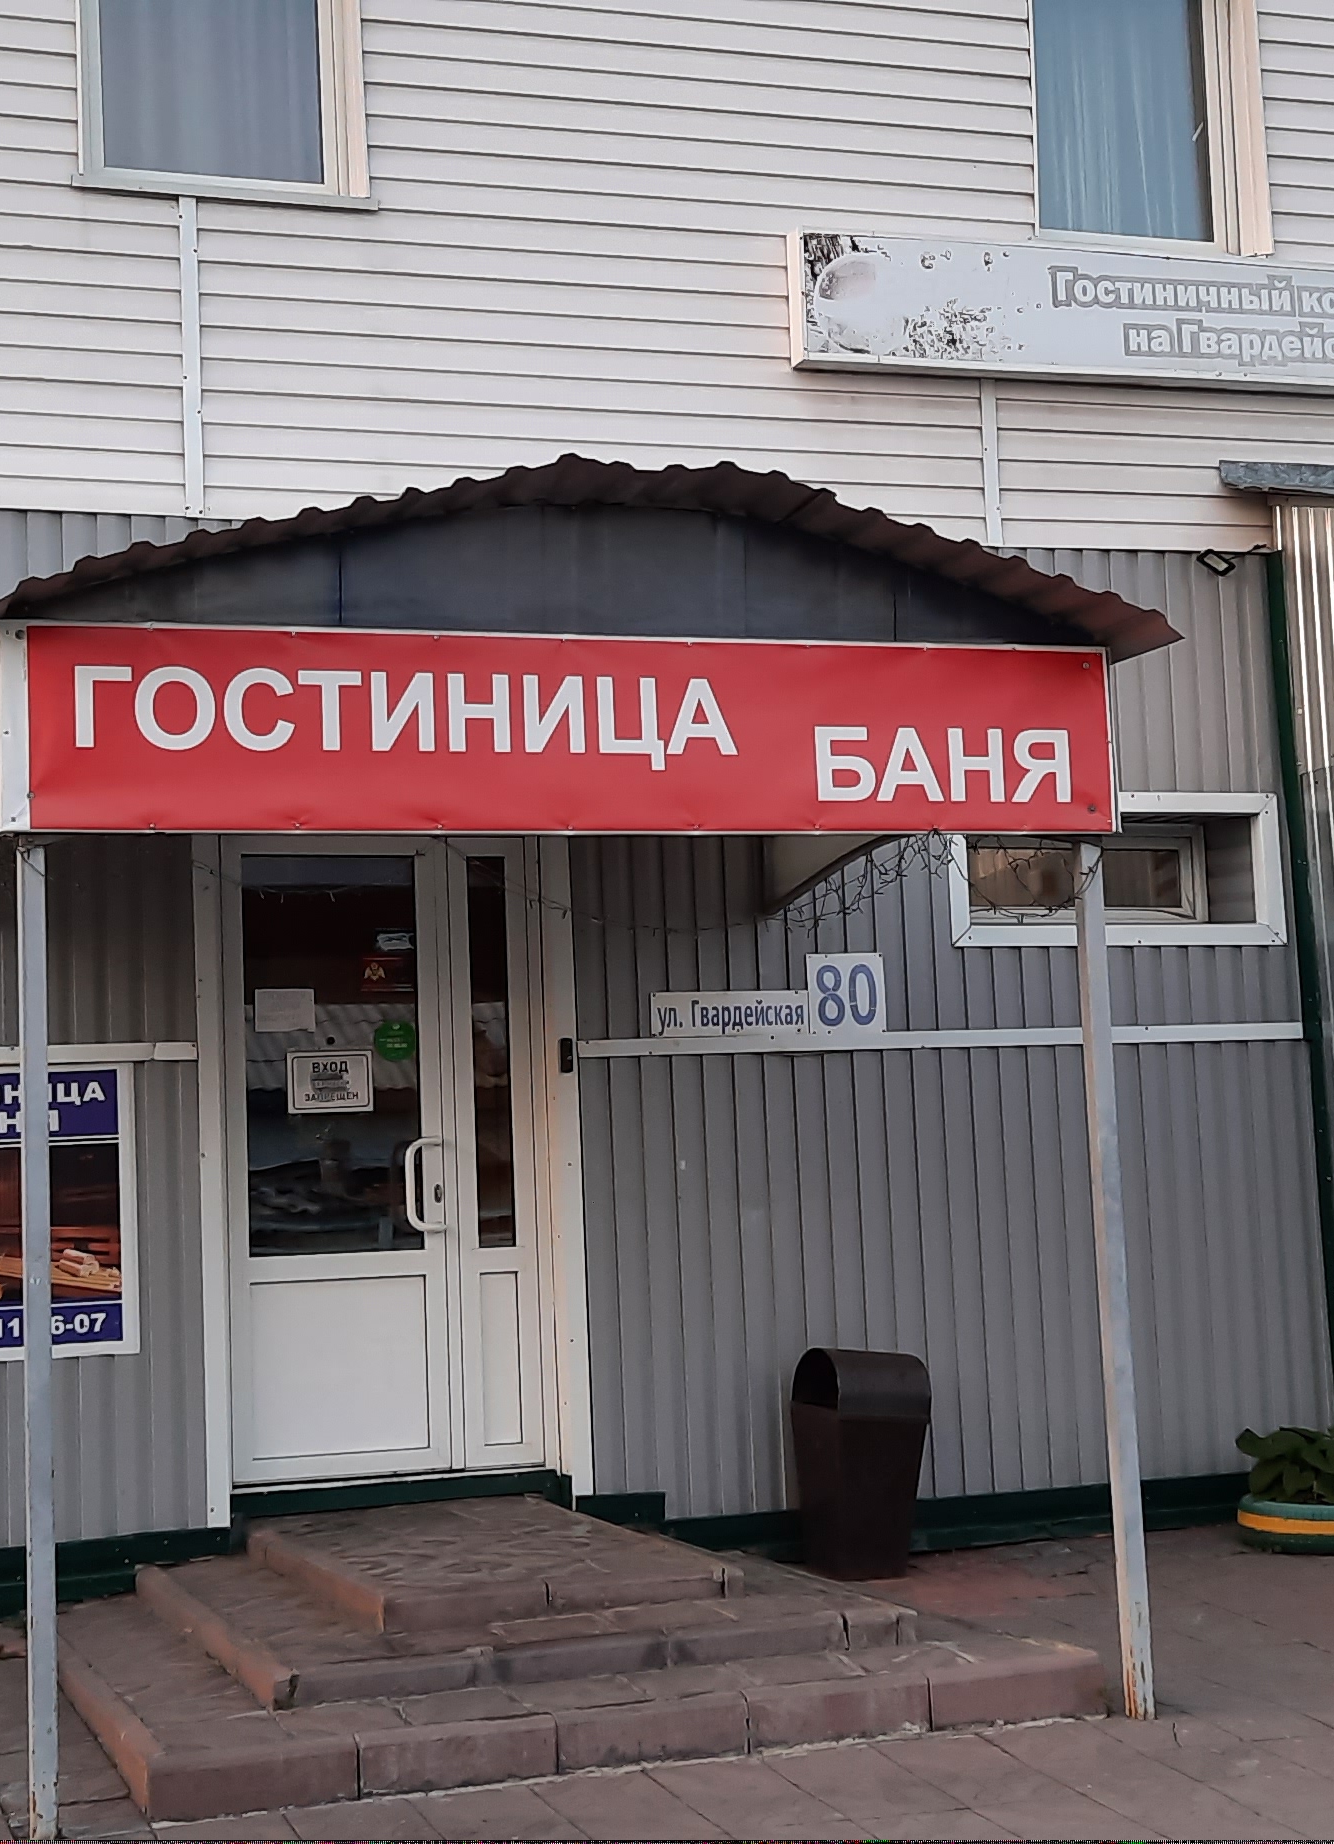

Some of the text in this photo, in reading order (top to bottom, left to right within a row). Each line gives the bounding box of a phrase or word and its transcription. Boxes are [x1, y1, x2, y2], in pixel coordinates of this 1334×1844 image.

[1055, 270, 1293, 315] Гостиничный
[1127, 326, 1170, 353] на
[72, 664, 740, 771] ГОСТИНИЦА
[813, 725, 1074, 804] БАНЯ
[656, 999, 805, 1036] ул. Гвардейская
[815, 963, 878, 1027] 80
[311, 1060, 349, 1074] ВХОД
